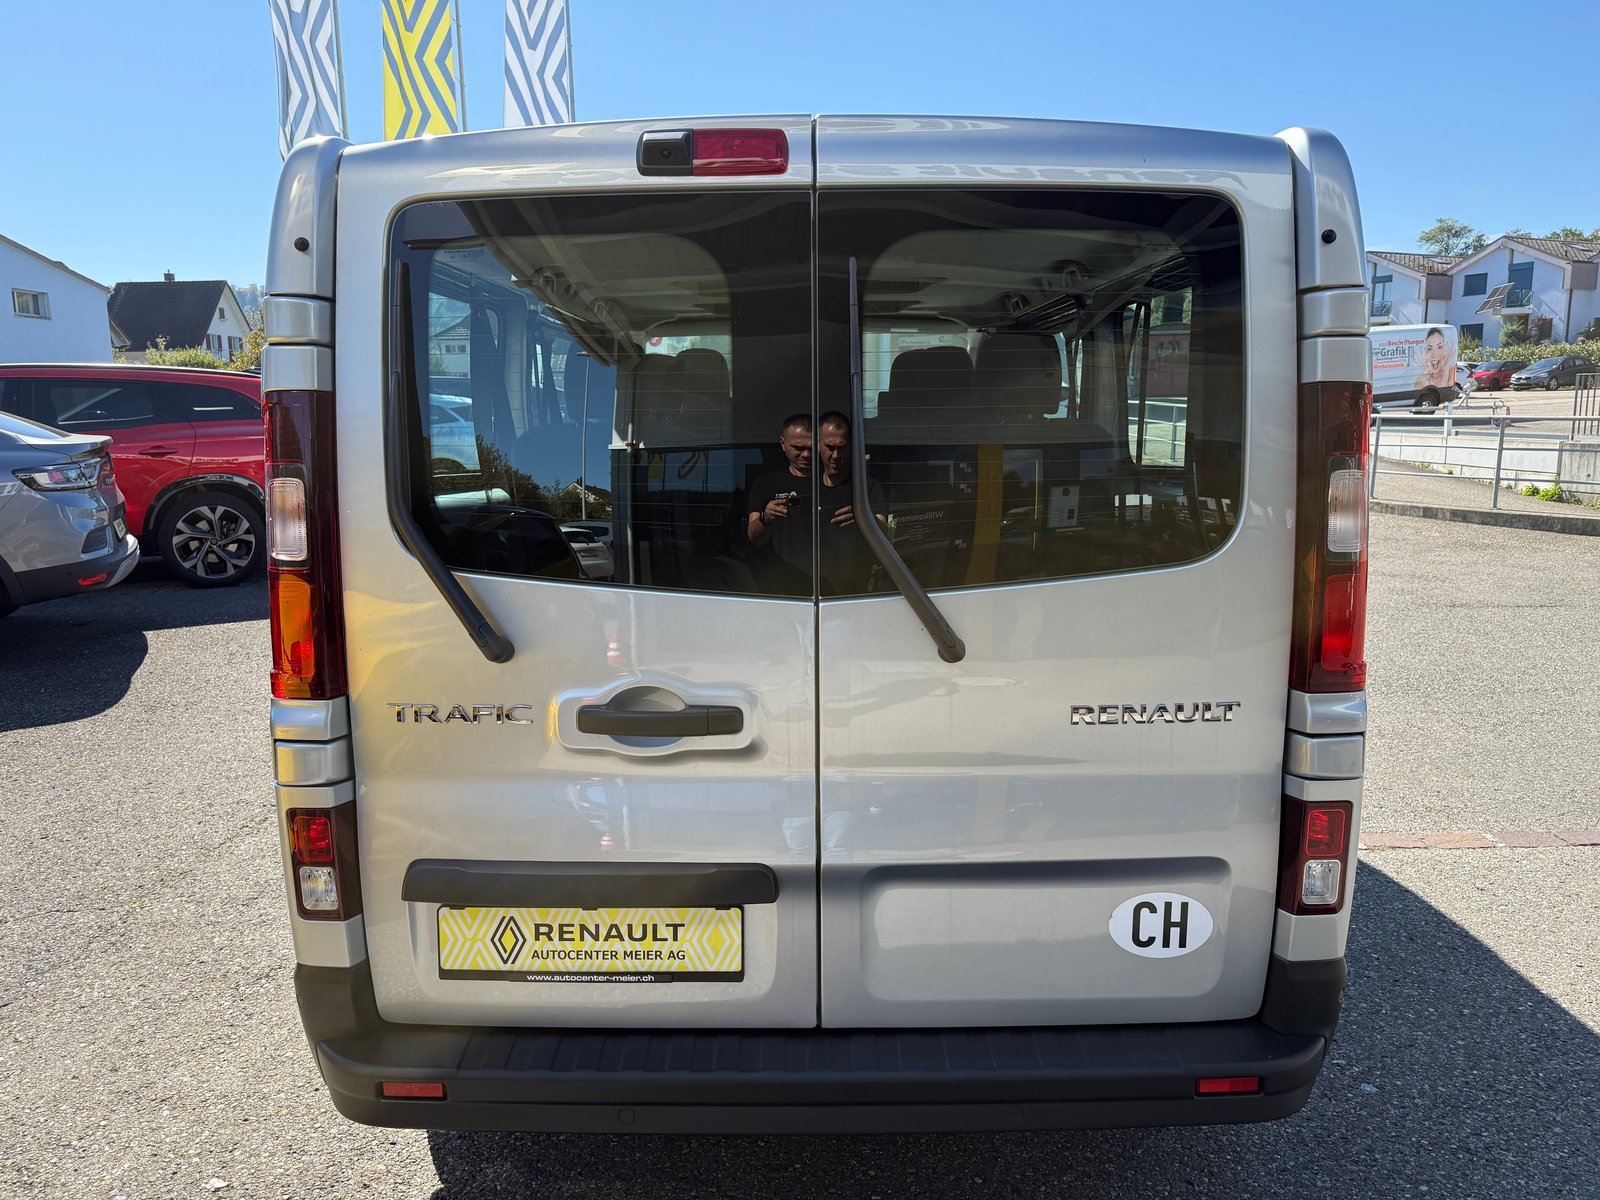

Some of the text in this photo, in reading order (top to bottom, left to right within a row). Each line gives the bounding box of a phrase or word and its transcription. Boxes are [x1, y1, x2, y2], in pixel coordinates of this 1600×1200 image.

[1388, 339, 1425, 347] Beschriftungen
[1380, 347, 1407, 356] Grafik
[386, 702, 533, 725] TRAFIC
[1070, 701, 1241, 725] RENAULT
[533, 922, 686, 942] RENAULT
[1131, 901, 1189, 949] CH
[531, 949, 686, 961] AUTOCENTER MEIER AG
[526, 973, 655, 983] www.autocenter-meier.ch
